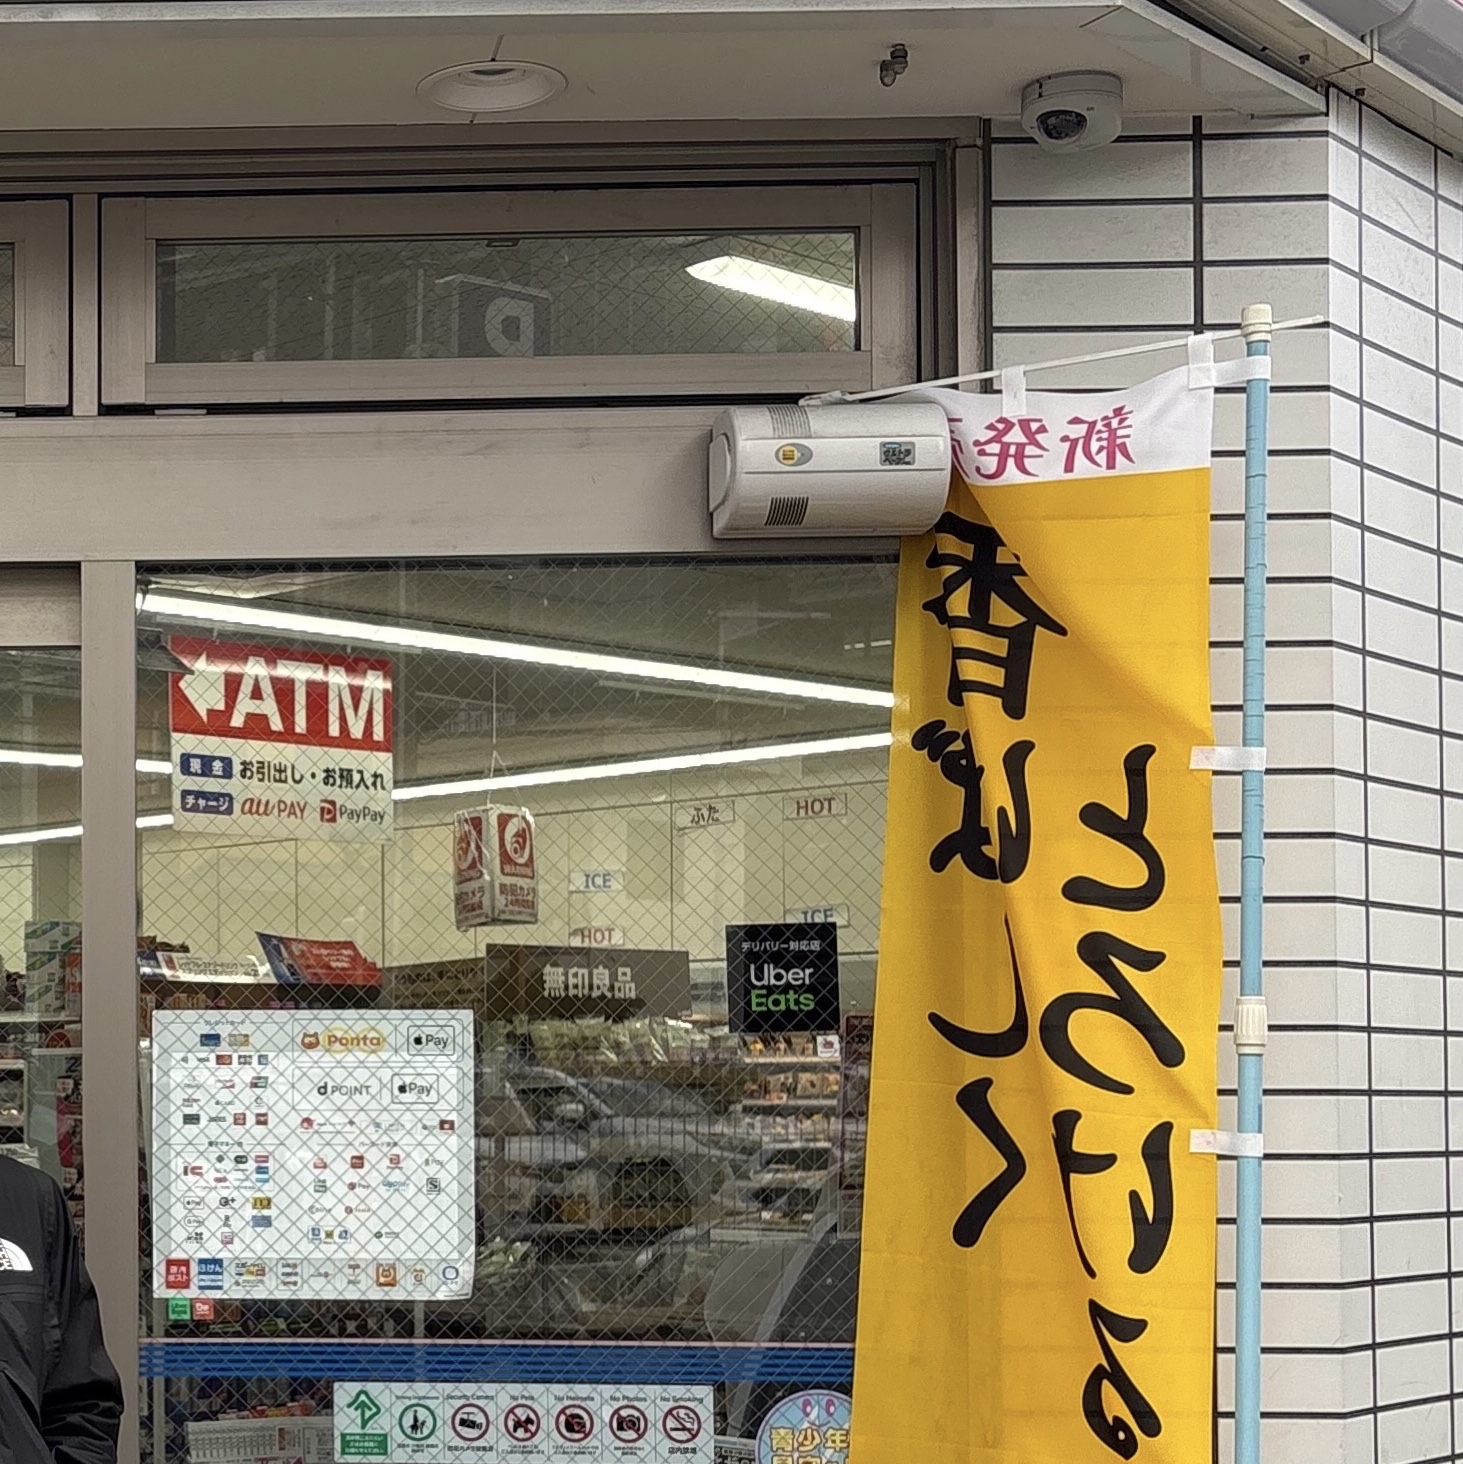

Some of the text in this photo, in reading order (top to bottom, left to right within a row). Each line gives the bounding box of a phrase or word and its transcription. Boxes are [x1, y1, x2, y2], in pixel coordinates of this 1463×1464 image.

[229, 655, 385, 742] ATM
[239, 760, 386, 791] お引出し・お預入れ
[184, 796, 231, 813] チャージ
[277, 800, 307, 818] PAY
[795, 799, 834, 817] HOT
[339, 804, 385, 824] PayPay
[689, 804, 721, 824] ふた
[583, 873, 613, 890] ICE
[580, 928, 615, 944] HOT
[542, 966, 636, 999] 無印良品
[749, 963, 814, 986] Uber
[750, 990, 815, 1012] Eats
[326, 1033, 382, 1048] Ponta
[425, 1034, 450, 1048] Pay
[331, 1085, 371, 1096] POINT
[408, 1082, 433, 1097] Pay
